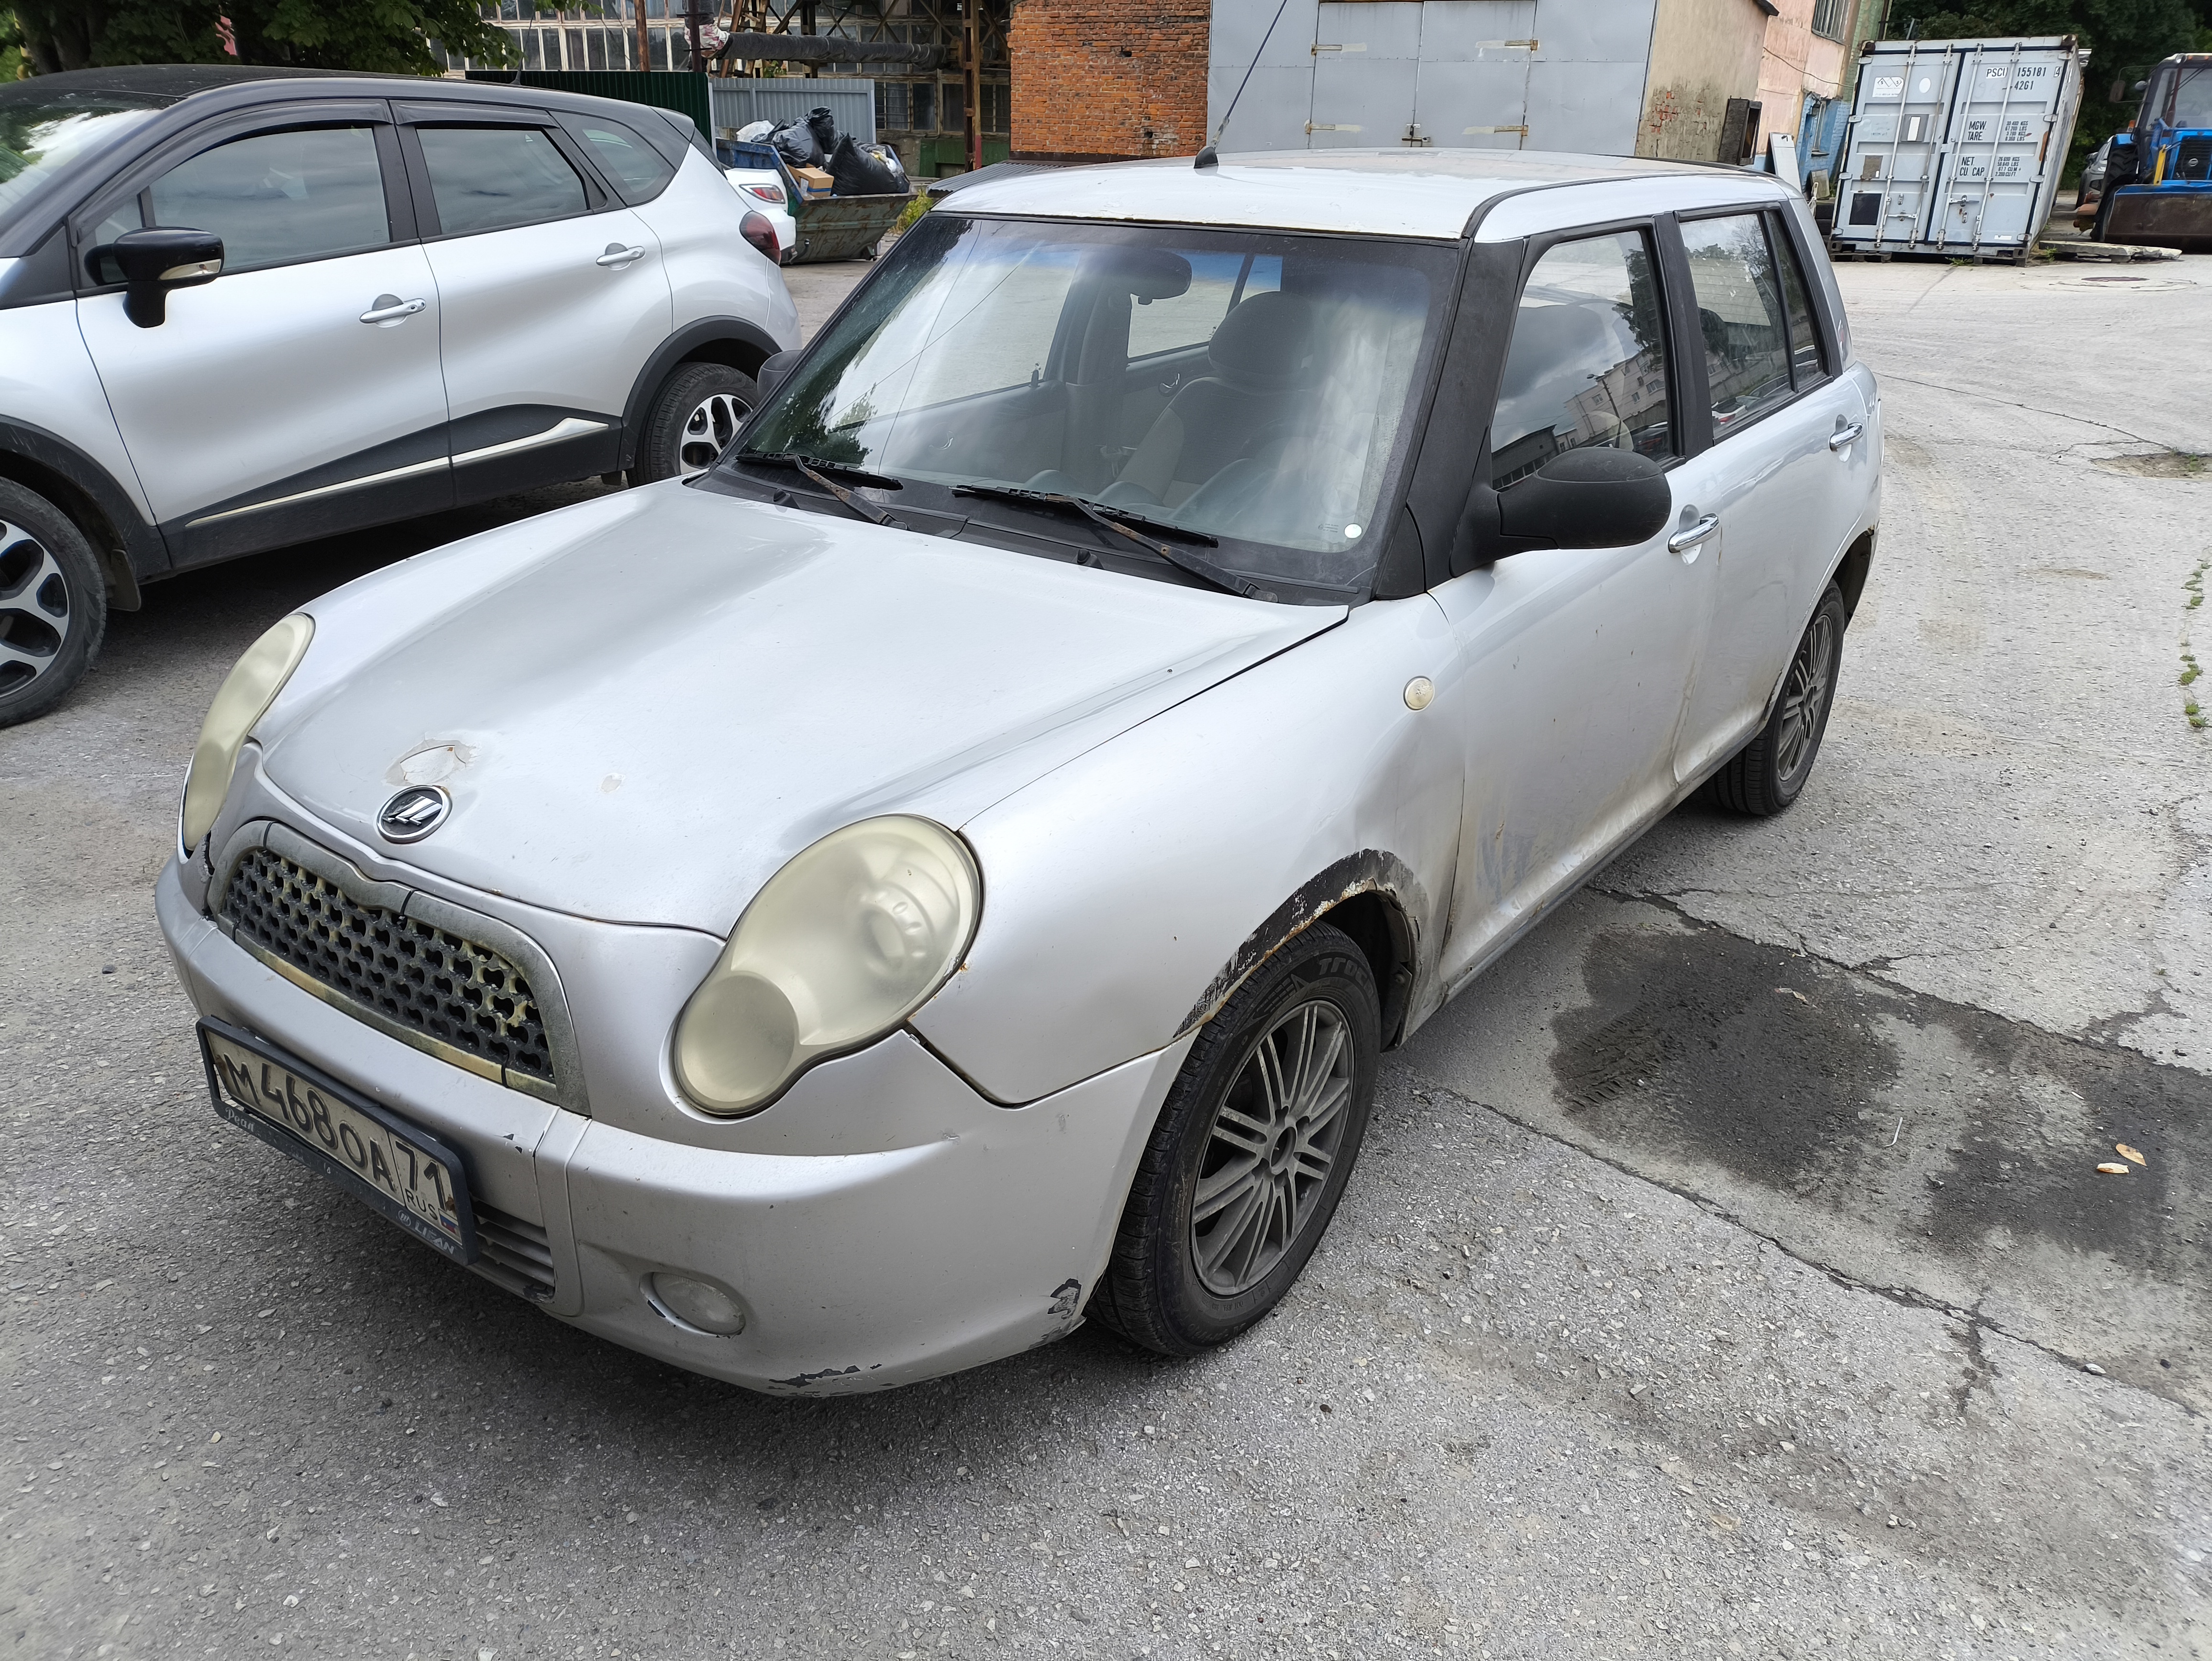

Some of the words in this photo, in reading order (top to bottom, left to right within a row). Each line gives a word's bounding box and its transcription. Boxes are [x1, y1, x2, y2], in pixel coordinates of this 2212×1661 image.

[2017, 67, 2046, 77] 155181
[2014, 80, 2034, 90] 42G1
[1968, 132, 1983, 141] TARE
[395, 1141, 447, 1211] 71
[405, 1188, 438, 1220] RUS
[415, 1220, 454, 1254] LIFAN
